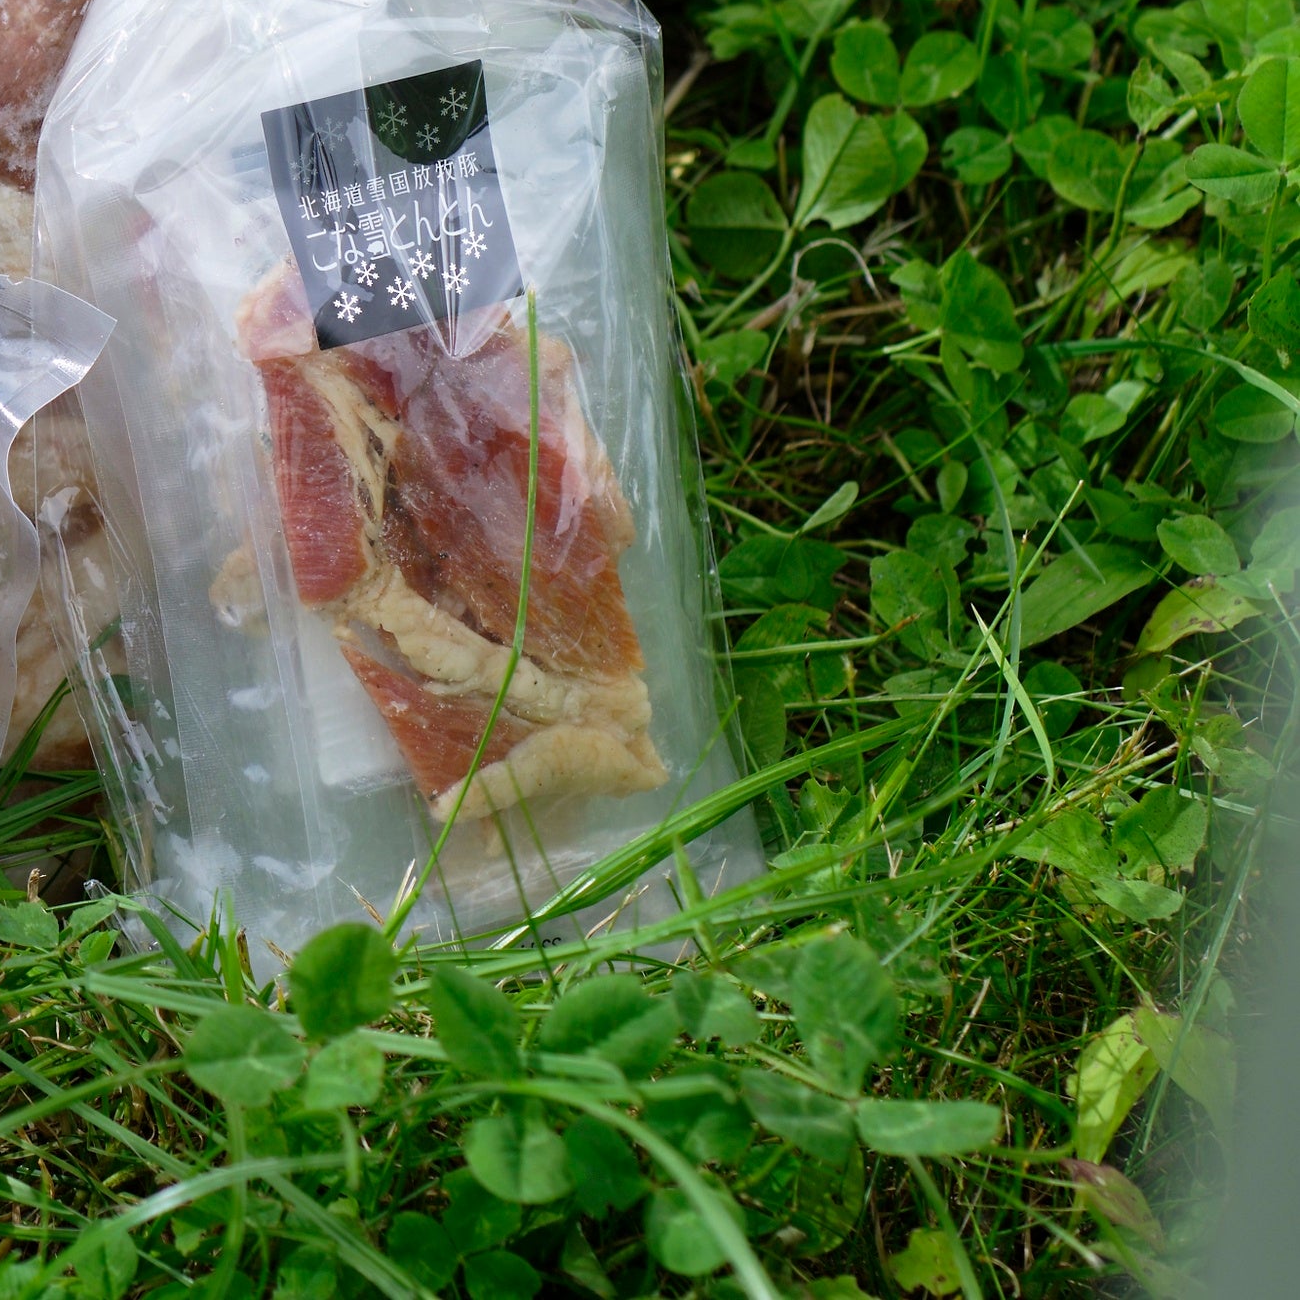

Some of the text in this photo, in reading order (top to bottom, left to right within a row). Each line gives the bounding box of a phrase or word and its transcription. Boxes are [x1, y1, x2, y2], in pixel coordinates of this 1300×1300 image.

[298, 152, 480, 222] 北海道雪国放牧豚
[305, 186, 494, 273] こな雪とんとん
